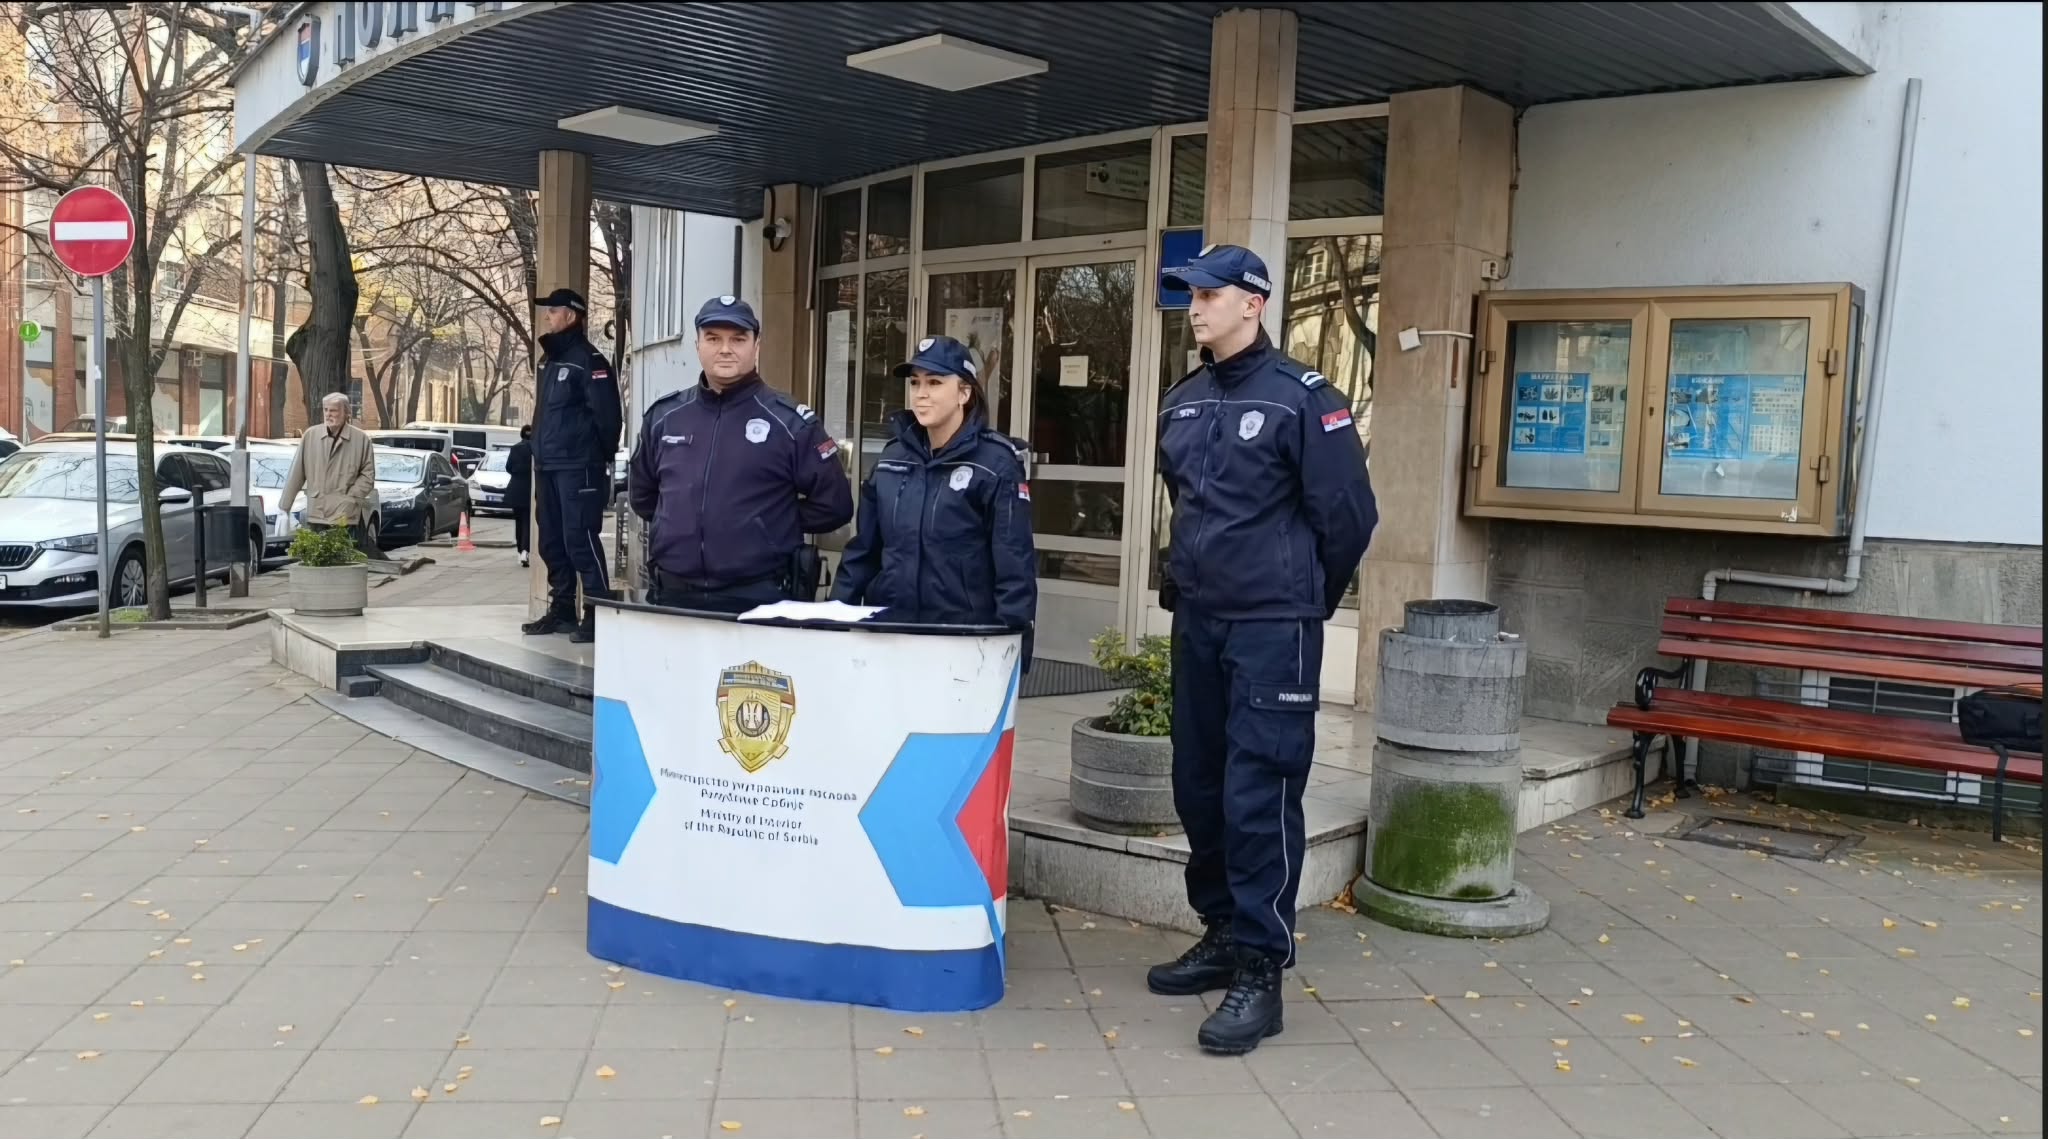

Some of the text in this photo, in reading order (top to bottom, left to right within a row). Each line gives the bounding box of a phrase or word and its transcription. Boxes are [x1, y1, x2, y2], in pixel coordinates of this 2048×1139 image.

[762, 796, 804, 811] Србије
[701, 808, 802, 830] Ministry of Interior
[684, 821, 819, 846] of the Republic of Serbia
